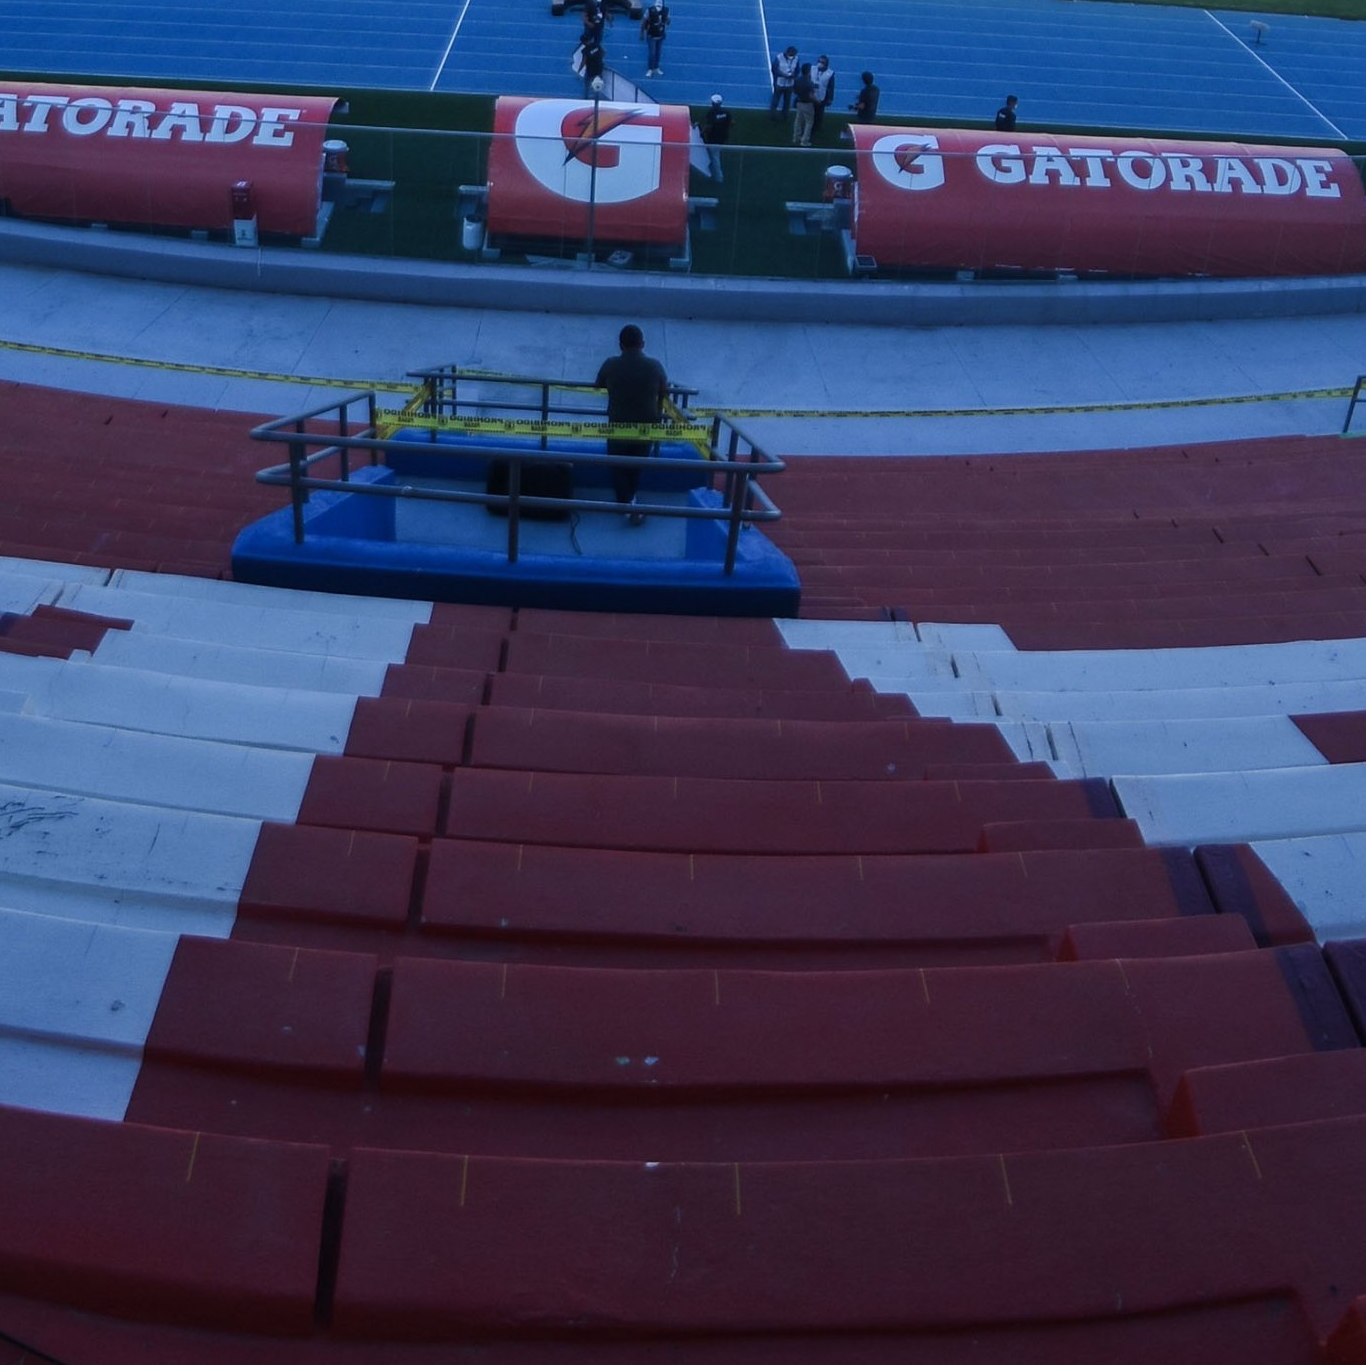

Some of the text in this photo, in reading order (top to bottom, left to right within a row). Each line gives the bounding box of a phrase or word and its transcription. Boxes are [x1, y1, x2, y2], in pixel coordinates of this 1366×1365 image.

[514, 100, 661, 203] G
[871, 133, 1342, 198] G GATORADE
